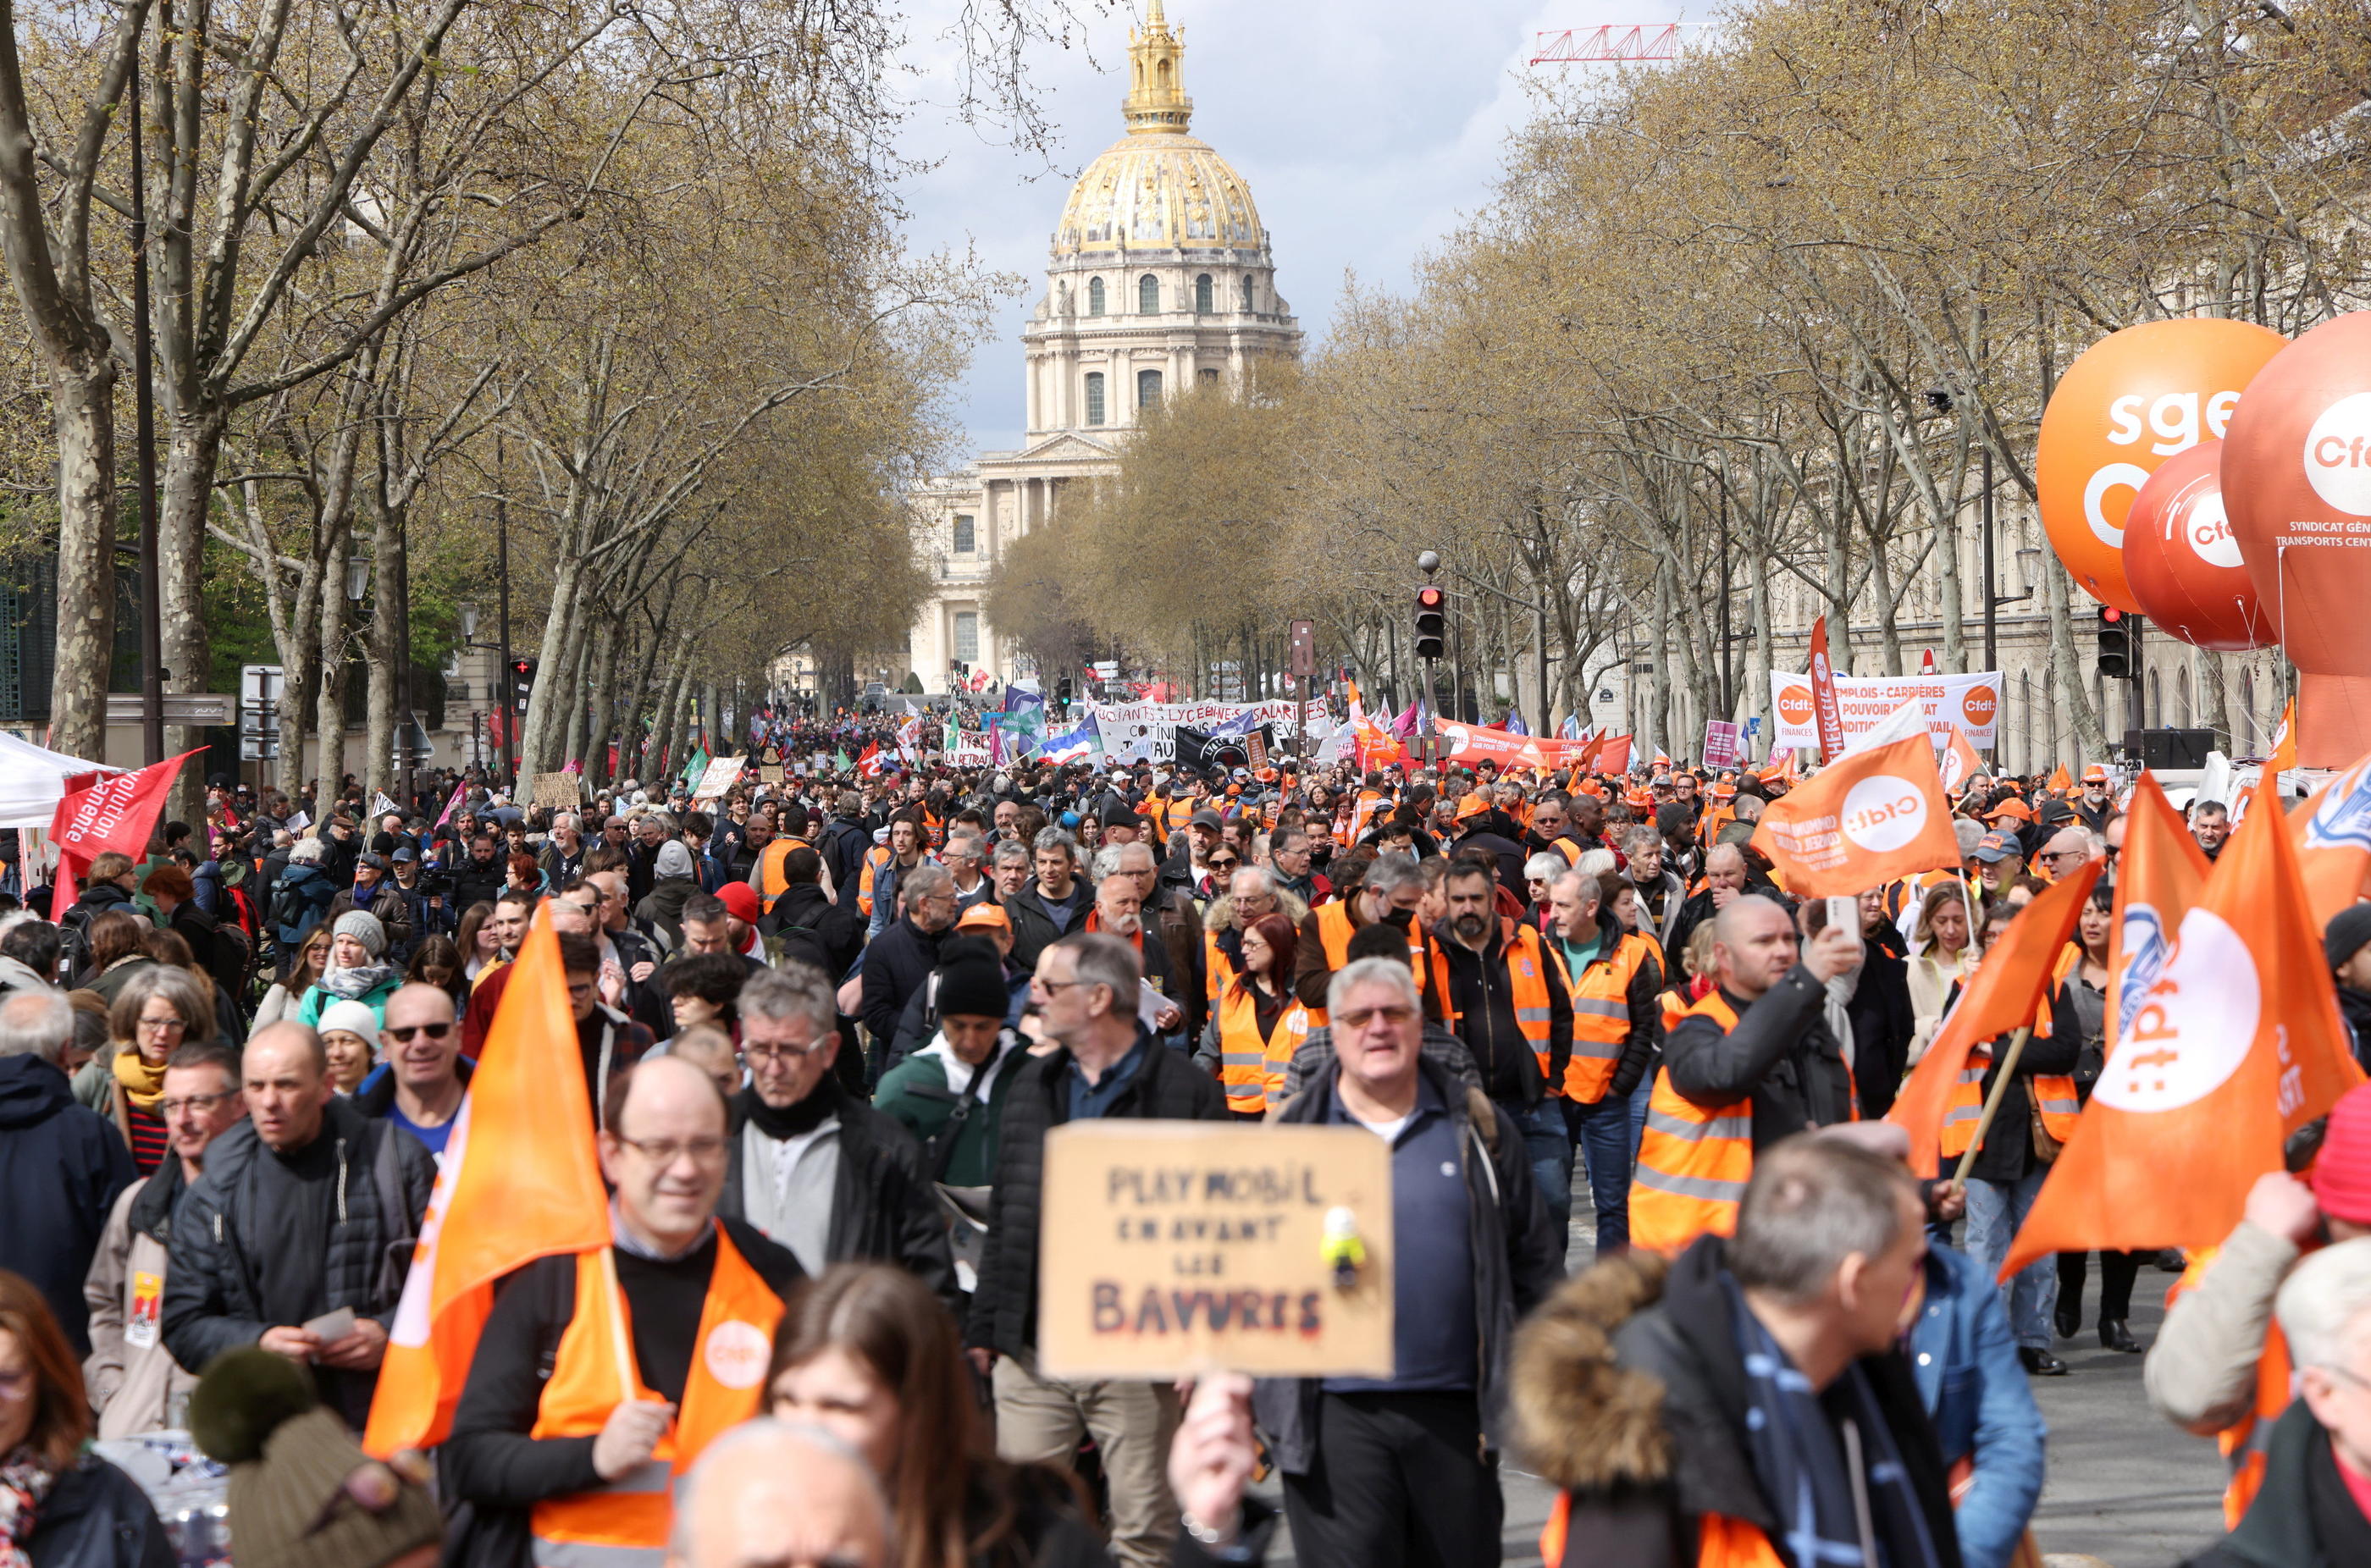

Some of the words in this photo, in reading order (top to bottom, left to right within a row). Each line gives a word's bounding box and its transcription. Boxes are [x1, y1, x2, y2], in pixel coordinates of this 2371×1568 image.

[2314, 435, 2371, 468] Cf
[2290, 522, 2344, 532] SYNDICAT
[2275, 536, 2342, 546] TRANSPORTS
[1780, 698, 1813, 712] Cfdt:
[1843, 703, 1890, 715] POUVOIR
[1965, 699, 1996, 712] Cfdt:
[1782, 727, 1813, 737] FINANCES
[1965, 728, 1992, 737] FINANCES
